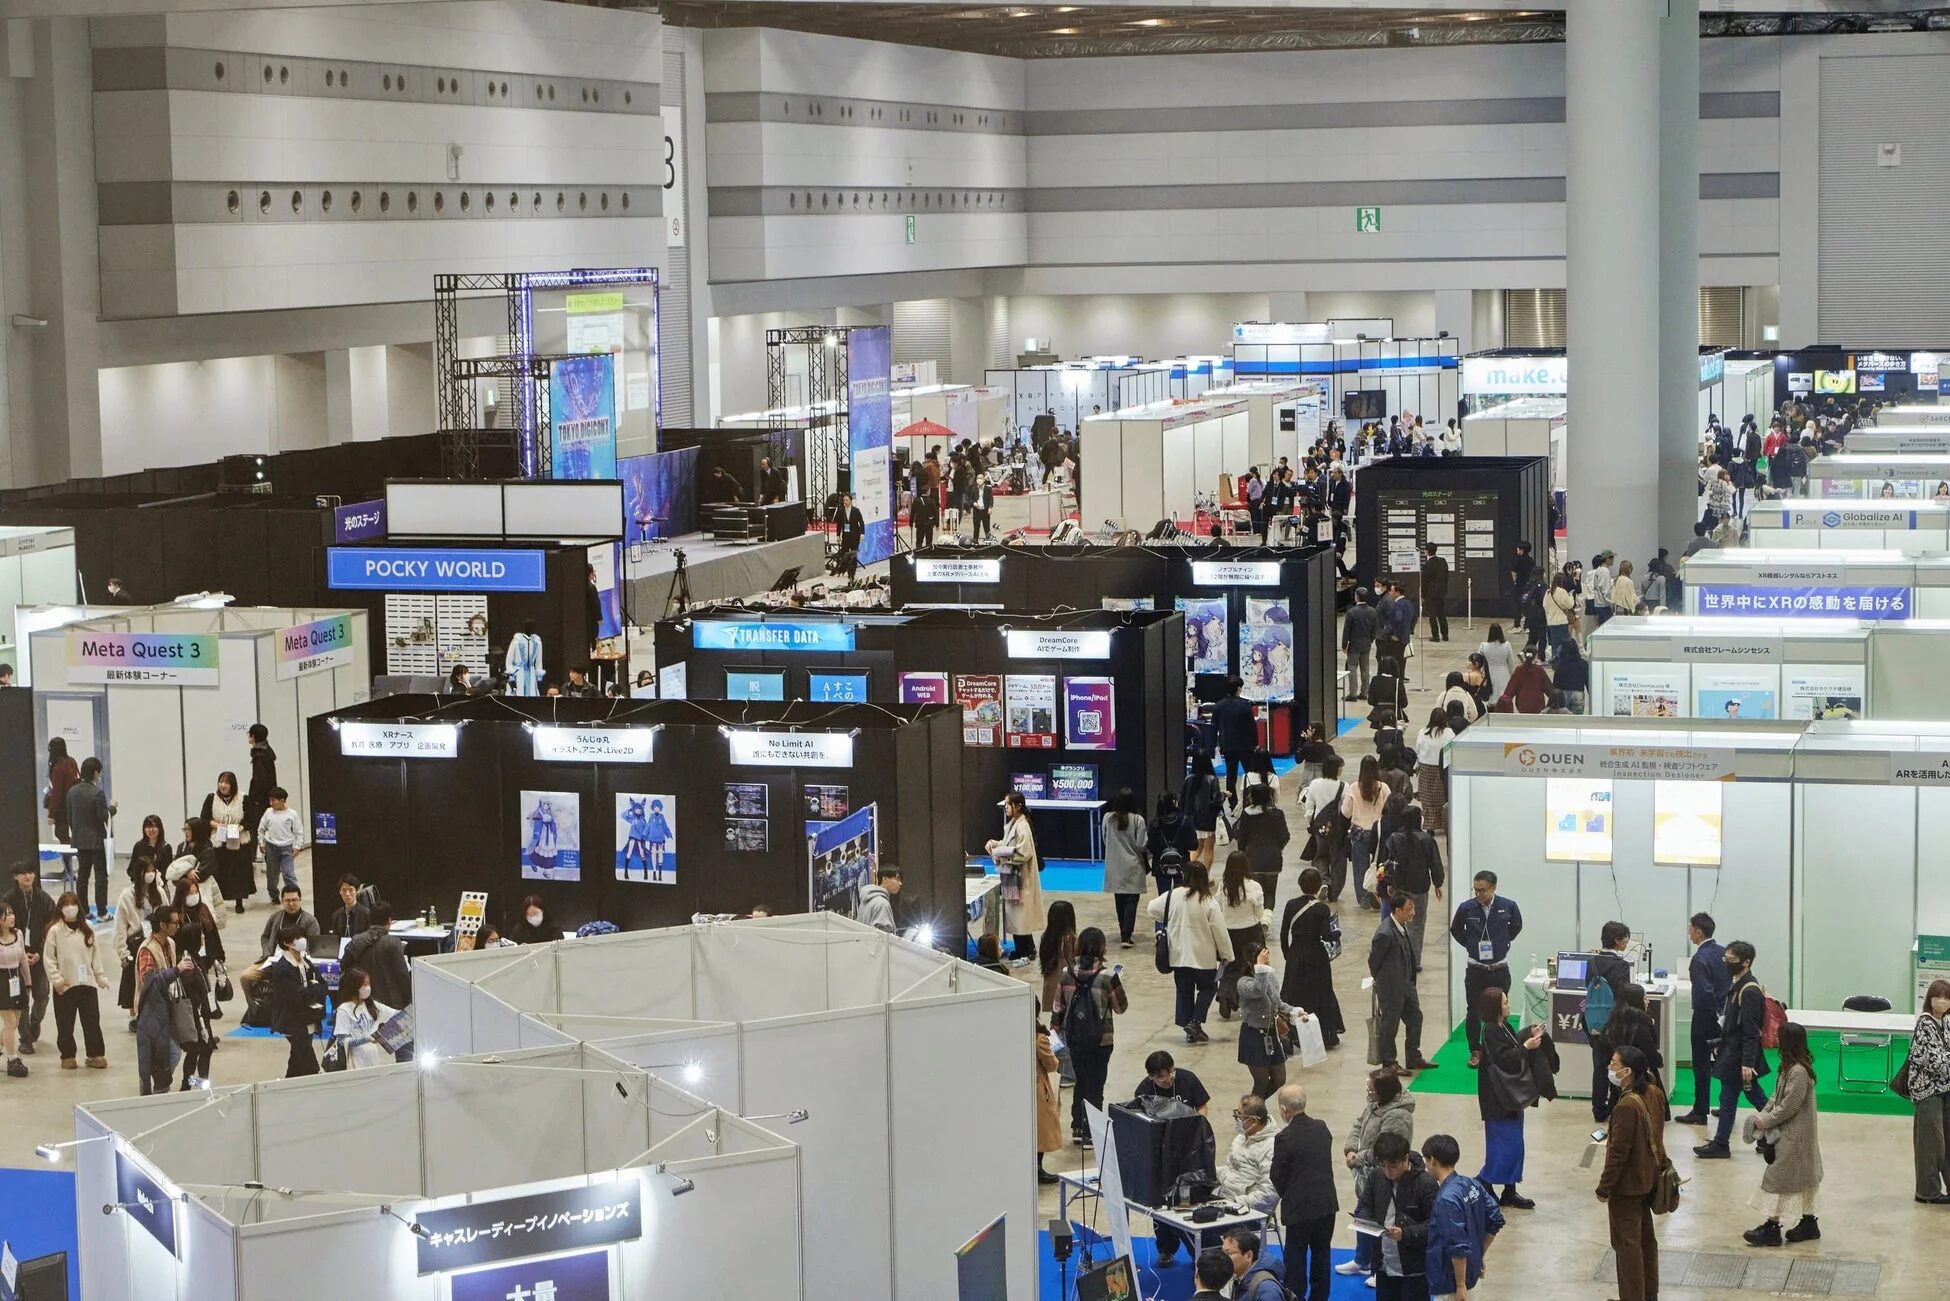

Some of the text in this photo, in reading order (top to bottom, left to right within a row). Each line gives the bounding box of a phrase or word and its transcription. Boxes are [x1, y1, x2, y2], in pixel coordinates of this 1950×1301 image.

[344, 511, 380, 531] 光のステージ
[1843, 513, 1903, 521] Globalize AI
[366, 560, 506, 578] POCKY WORLD
[1704, 594, 1905, 611] 世界中にXRの感動を届ける
[285, 624, 344, 652] Meta Quest 3
[739, 629, 820, 644] TRANSFER DATA
[82, 641, 201, 659] Meta Quest 3
[1683, 645, 1770, 654] 株式会社フレームシンセシス
[298, 656, 334, 672] 最新体験コーナー
[106, 670, 177, 681] 最新体験コーナー
[1070, 694, 1108, 702] iPhone/iPad
[383, 731, 413, 739] XRナース
[576, 735, 610, 743] うんじゅ丸
[369, 741, 382, 749] 医療
[390, 741, 409, 749] アプリ
[417, 741, 446, 750] 企画開発
[782, 740, 803, 748] Limit
[805, 740, 813, 748] AI
[1539, 753, 1584, 765] OUEN
[1665, 771, 1705, 779] Designer
[1013, 784, 1043, 792] ¥100,000
[1052, 779, 1094, 789] ¥500,000
[429, 1201, 630, 1248] キャスレーディープイノベーションズ
